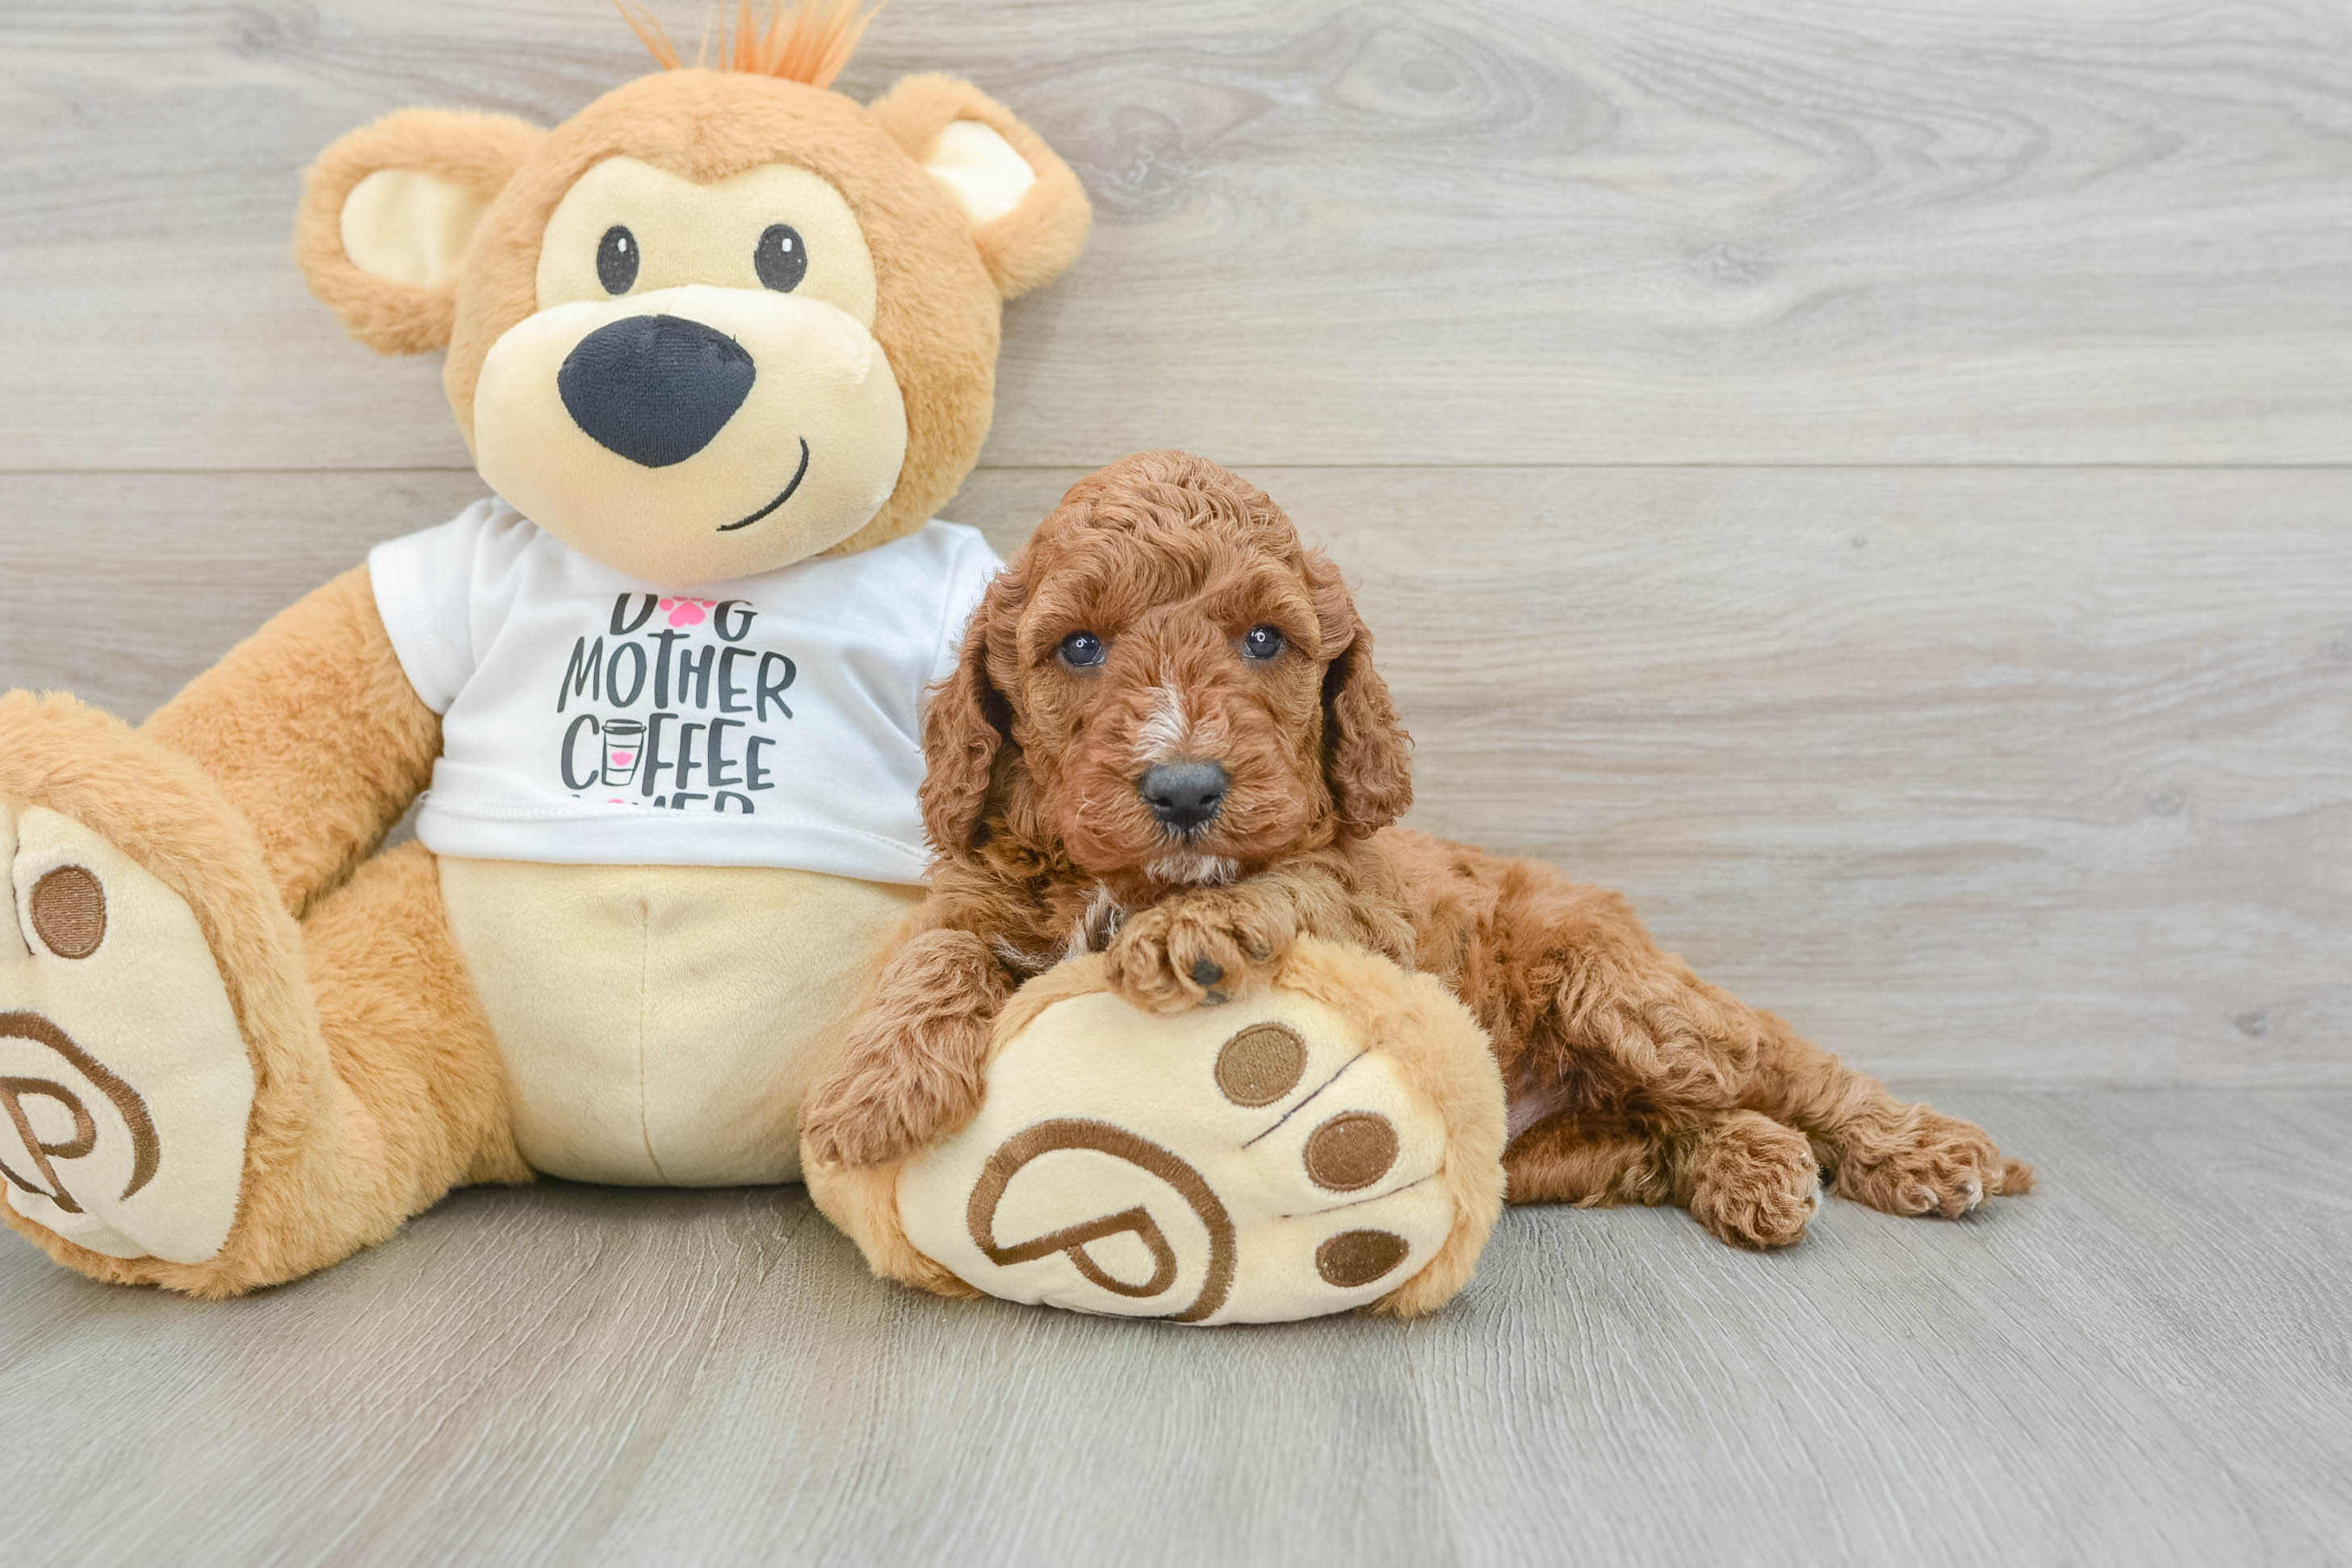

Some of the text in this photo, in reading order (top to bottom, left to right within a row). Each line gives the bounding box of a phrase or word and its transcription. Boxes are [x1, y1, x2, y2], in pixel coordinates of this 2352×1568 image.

[610, 593, 758, 642] DG
[557, 629, 797, 723] MOTHER
[560, 712, 776, 797] CFFEE
